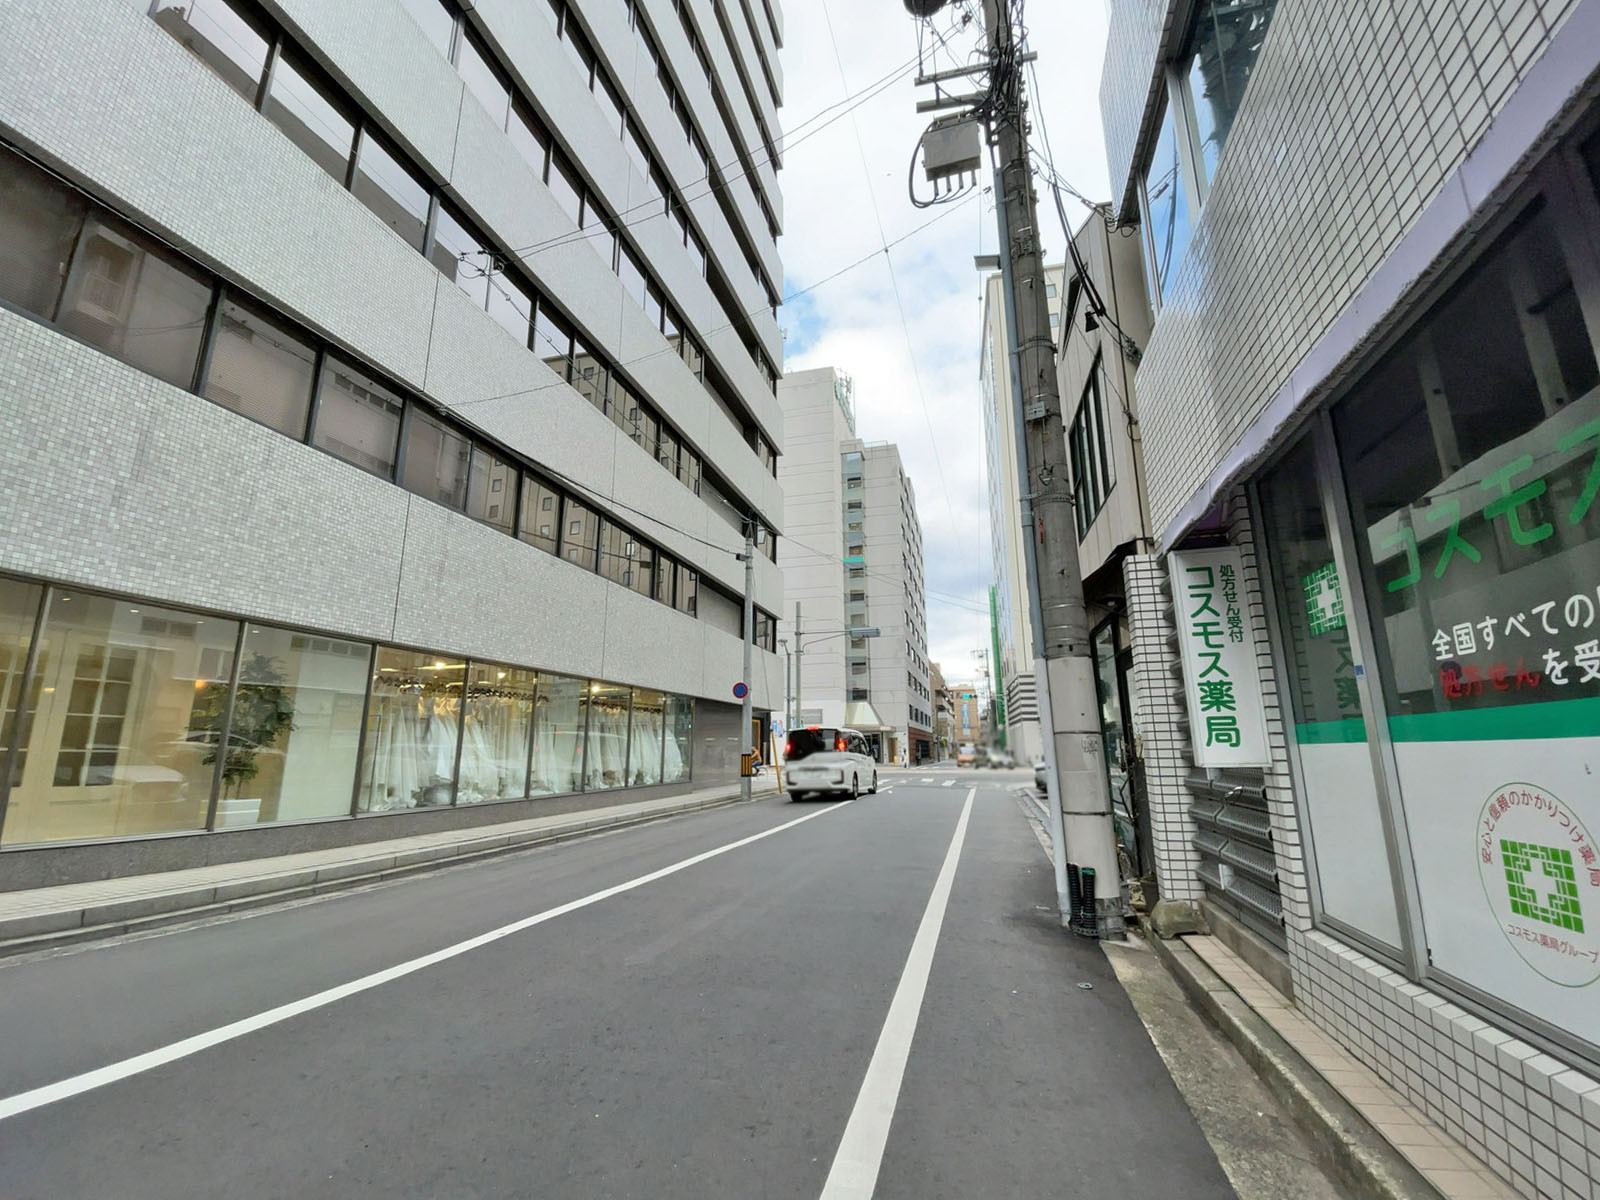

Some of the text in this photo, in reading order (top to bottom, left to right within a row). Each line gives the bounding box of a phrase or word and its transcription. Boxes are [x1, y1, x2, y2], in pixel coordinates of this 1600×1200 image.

[1219, 564, 1244, 643] 処方せん受付
[1432, 586, 1600, 660] 全国すべての
[1186, 566, 1241, 748] コスモス薬局
